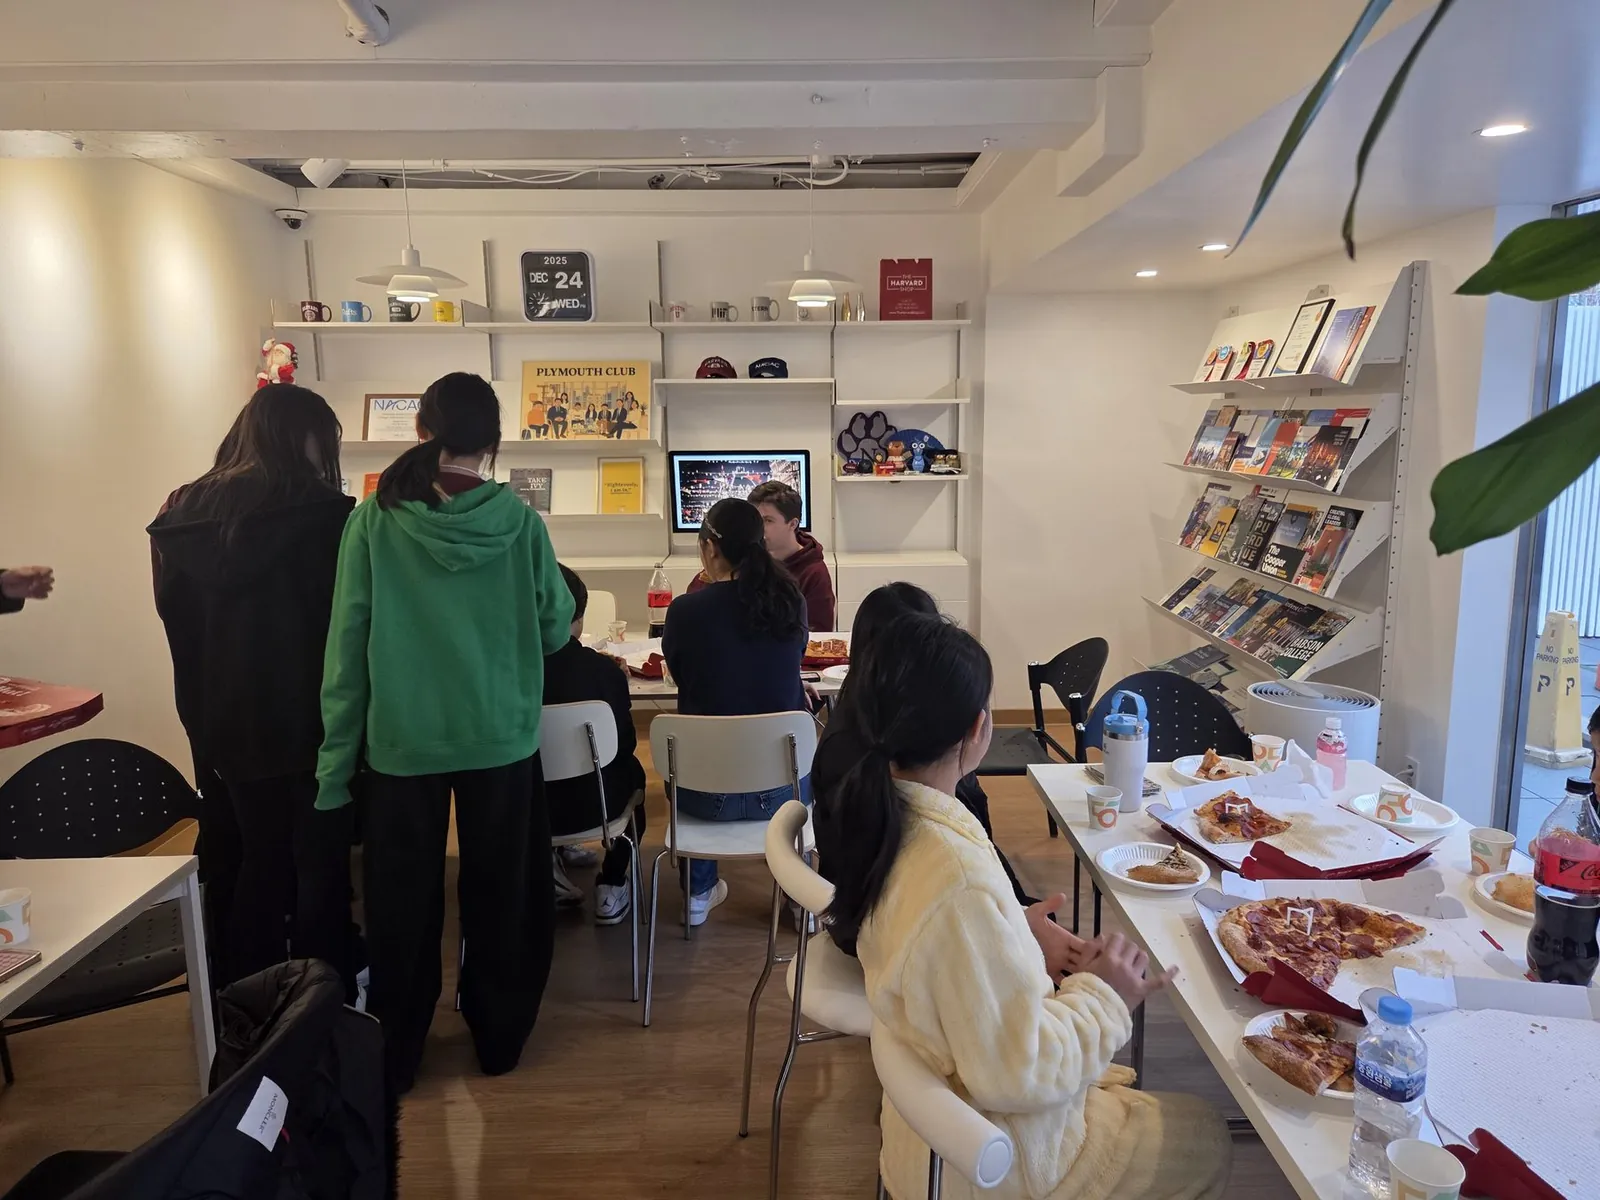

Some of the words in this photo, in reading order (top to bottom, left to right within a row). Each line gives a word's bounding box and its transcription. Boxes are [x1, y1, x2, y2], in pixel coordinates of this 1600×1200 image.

[544, 256, 568, 264] 2025
[529, 272, 548, 283] DEC
[554, 272, 584, 288] 24
[555, 298, 580, 308] WED
[536, 367, 602, 376] PLYMOUTH
[605, 367, 636, 376] CLUB
[1268, 544, 1280, 555] The
[1264, 554, 1286, 567] Cooper
[1262, 563, 1278, 576] Union
[1536, 653, 1559, 664] PARKING
[1358, 1061, 1392, 1088] 동원샘물
[259, 1093, 278, 1134] MONCLER
